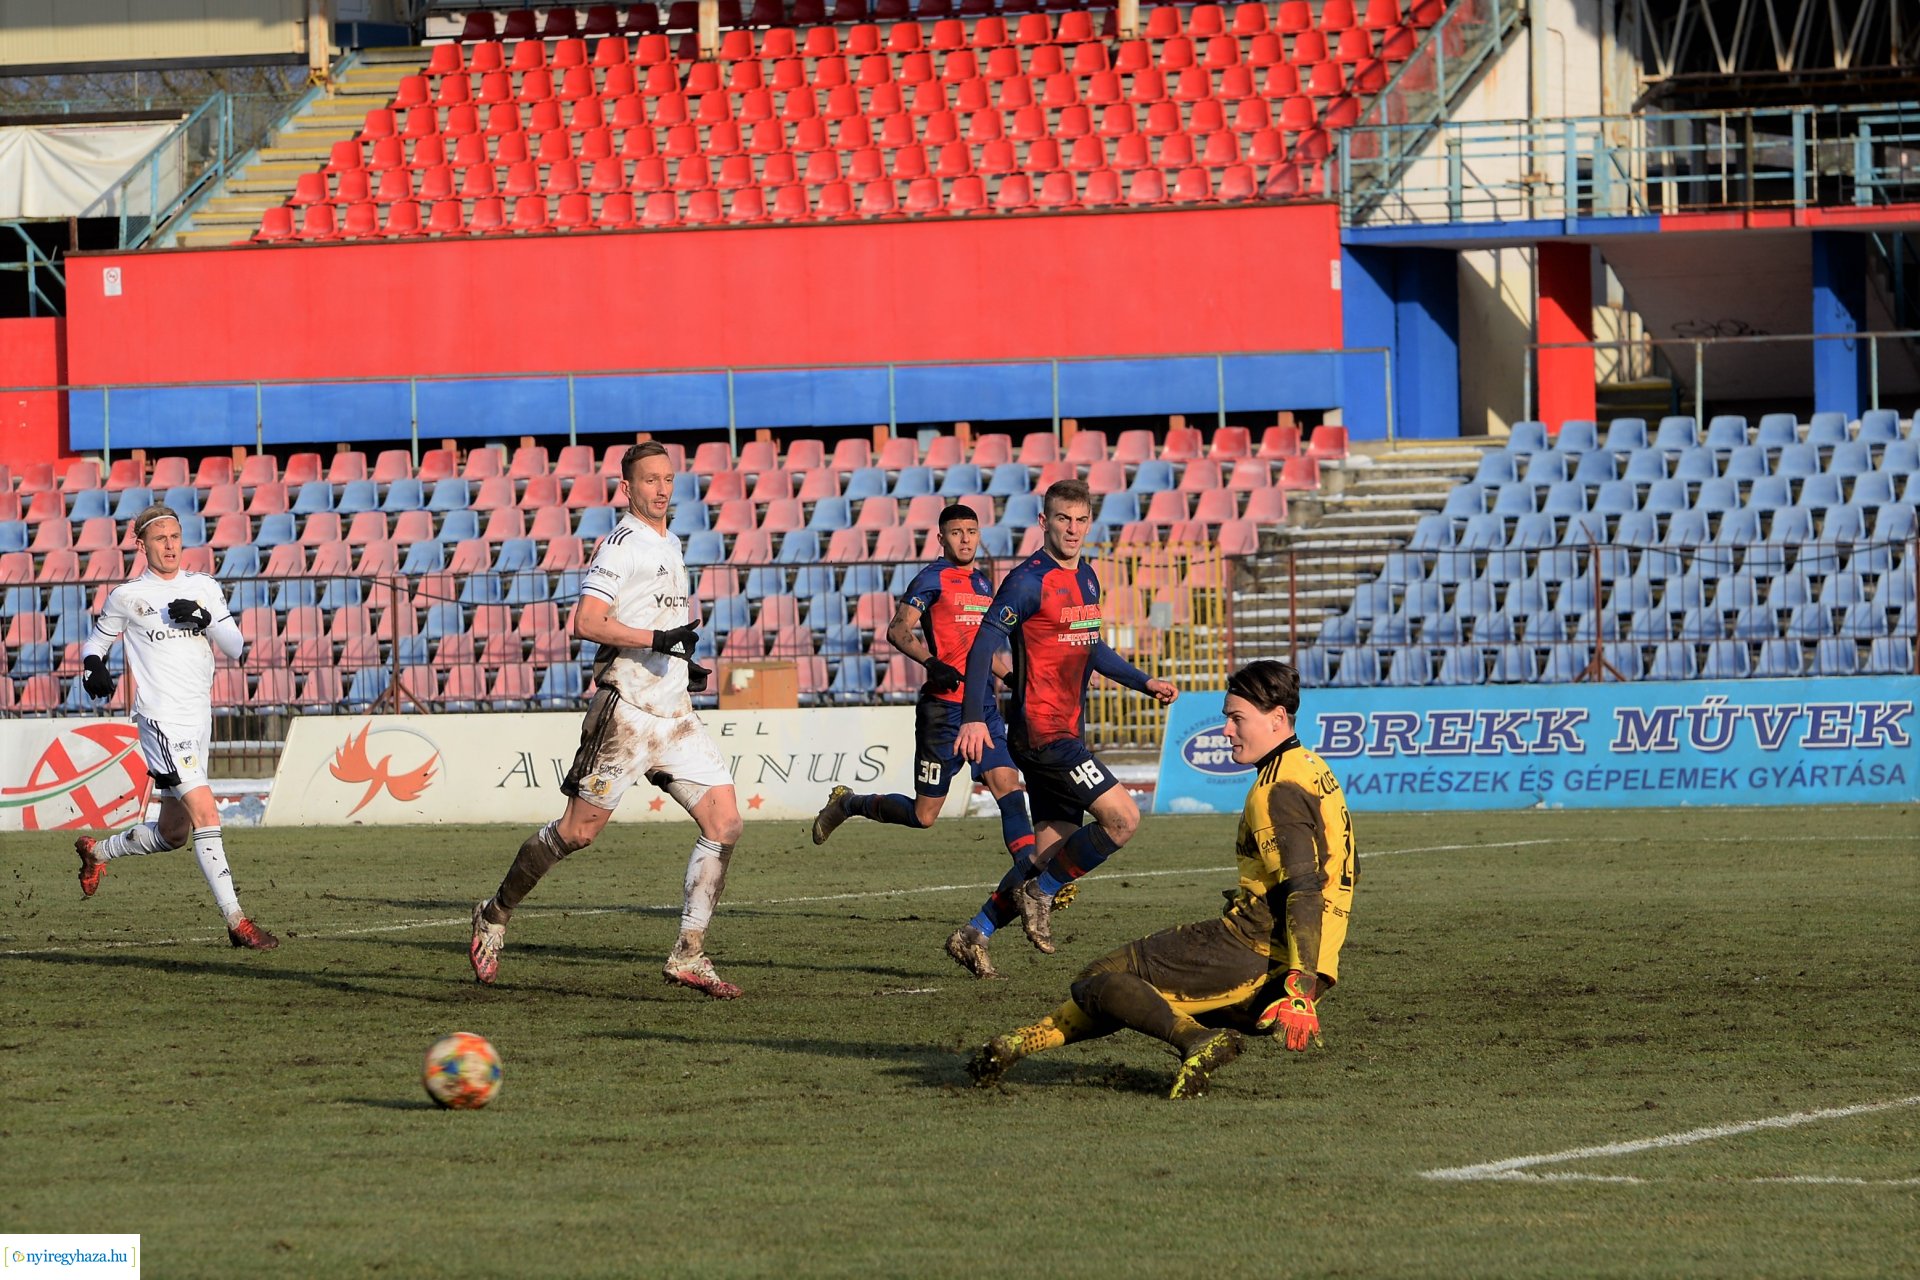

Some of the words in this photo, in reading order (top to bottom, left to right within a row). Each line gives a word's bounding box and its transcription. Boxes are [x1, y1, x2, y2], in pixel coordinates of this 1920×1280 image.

[1312, 708, 1588, 757] BREKK
[1610, 695, 1912, 751] MŰVEK
[918, 760, 941, 786] 30
[1069, 759, 1105, 789] 48
[1345, 765, 1510, 795] KATRÉSZEK
[1519, 764, 1554, 791] ÉS
[1563, 763, 1740, 791] GÉPELEMEK
[1748, 759, 1907, 789] GYÁRTÁSA
